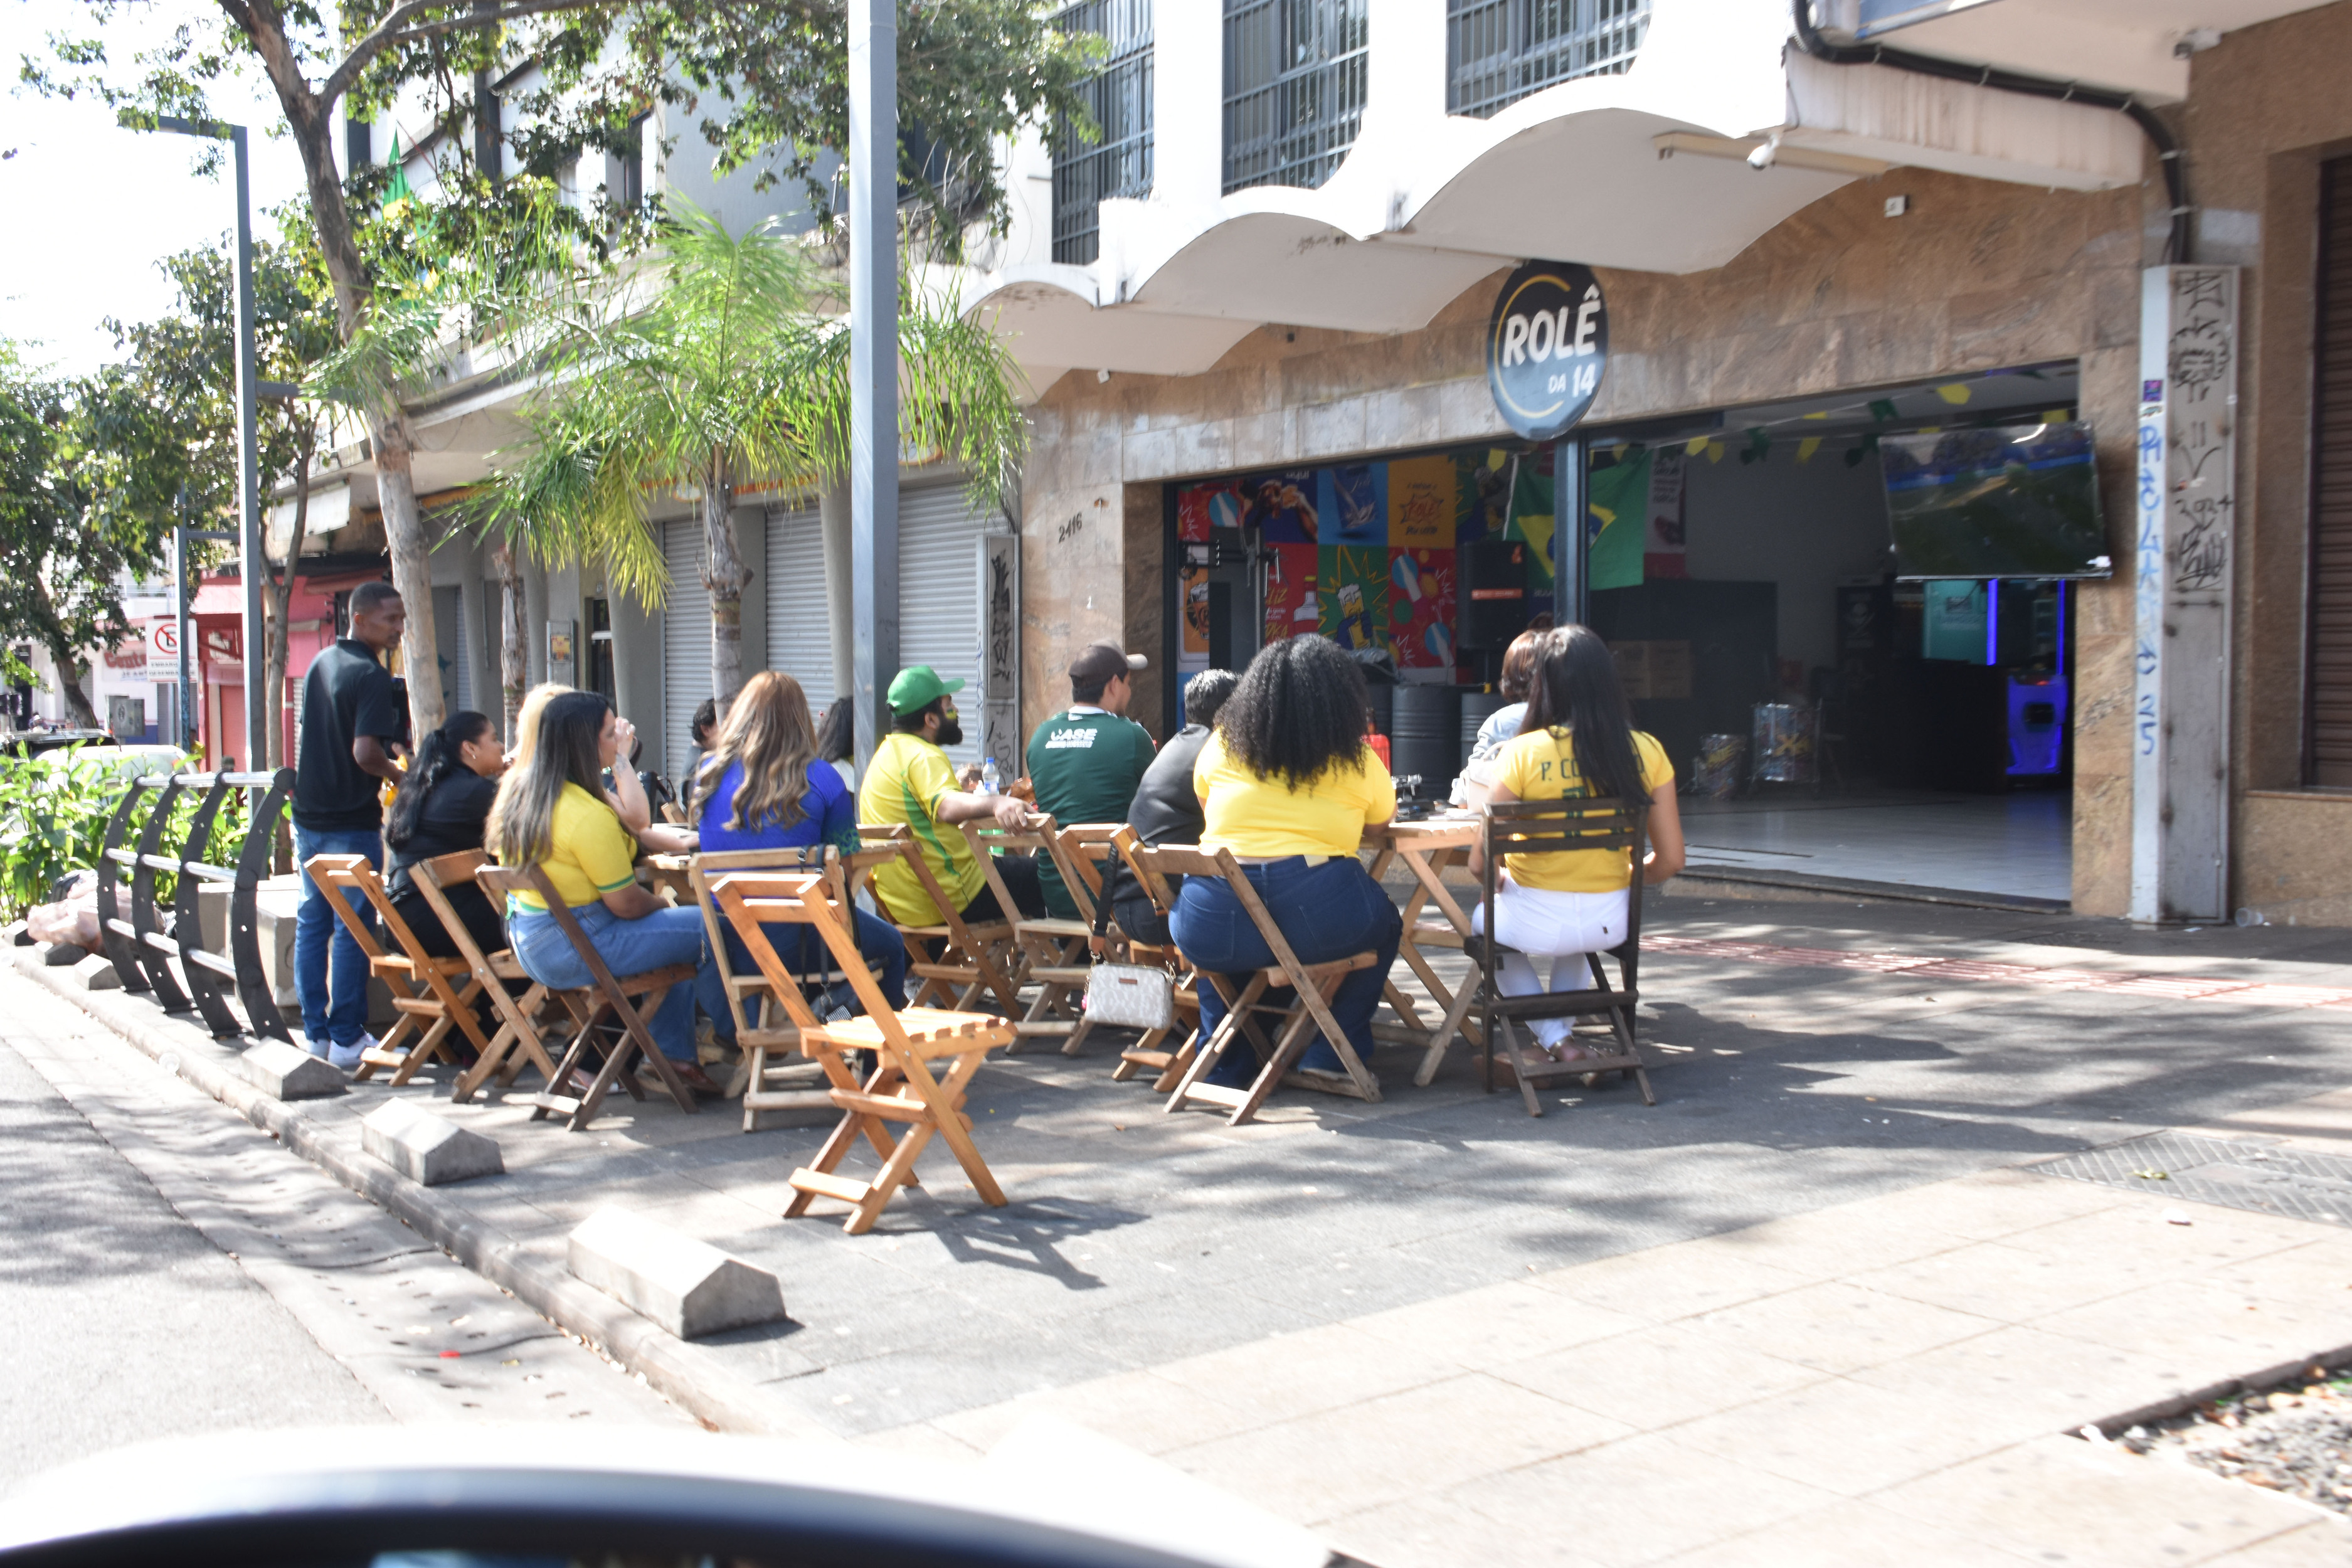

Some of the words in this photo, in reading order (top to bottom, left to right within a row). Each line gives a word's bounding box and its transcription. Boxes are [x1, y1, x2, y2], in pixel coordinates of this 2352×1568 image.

[1502, 283, 1601, 368] ROLÊ
[1548, 373, 1567, 395] DA
[1572, 363, 1596, 398] 14
[1059, 512, 1083, 544] 2416
